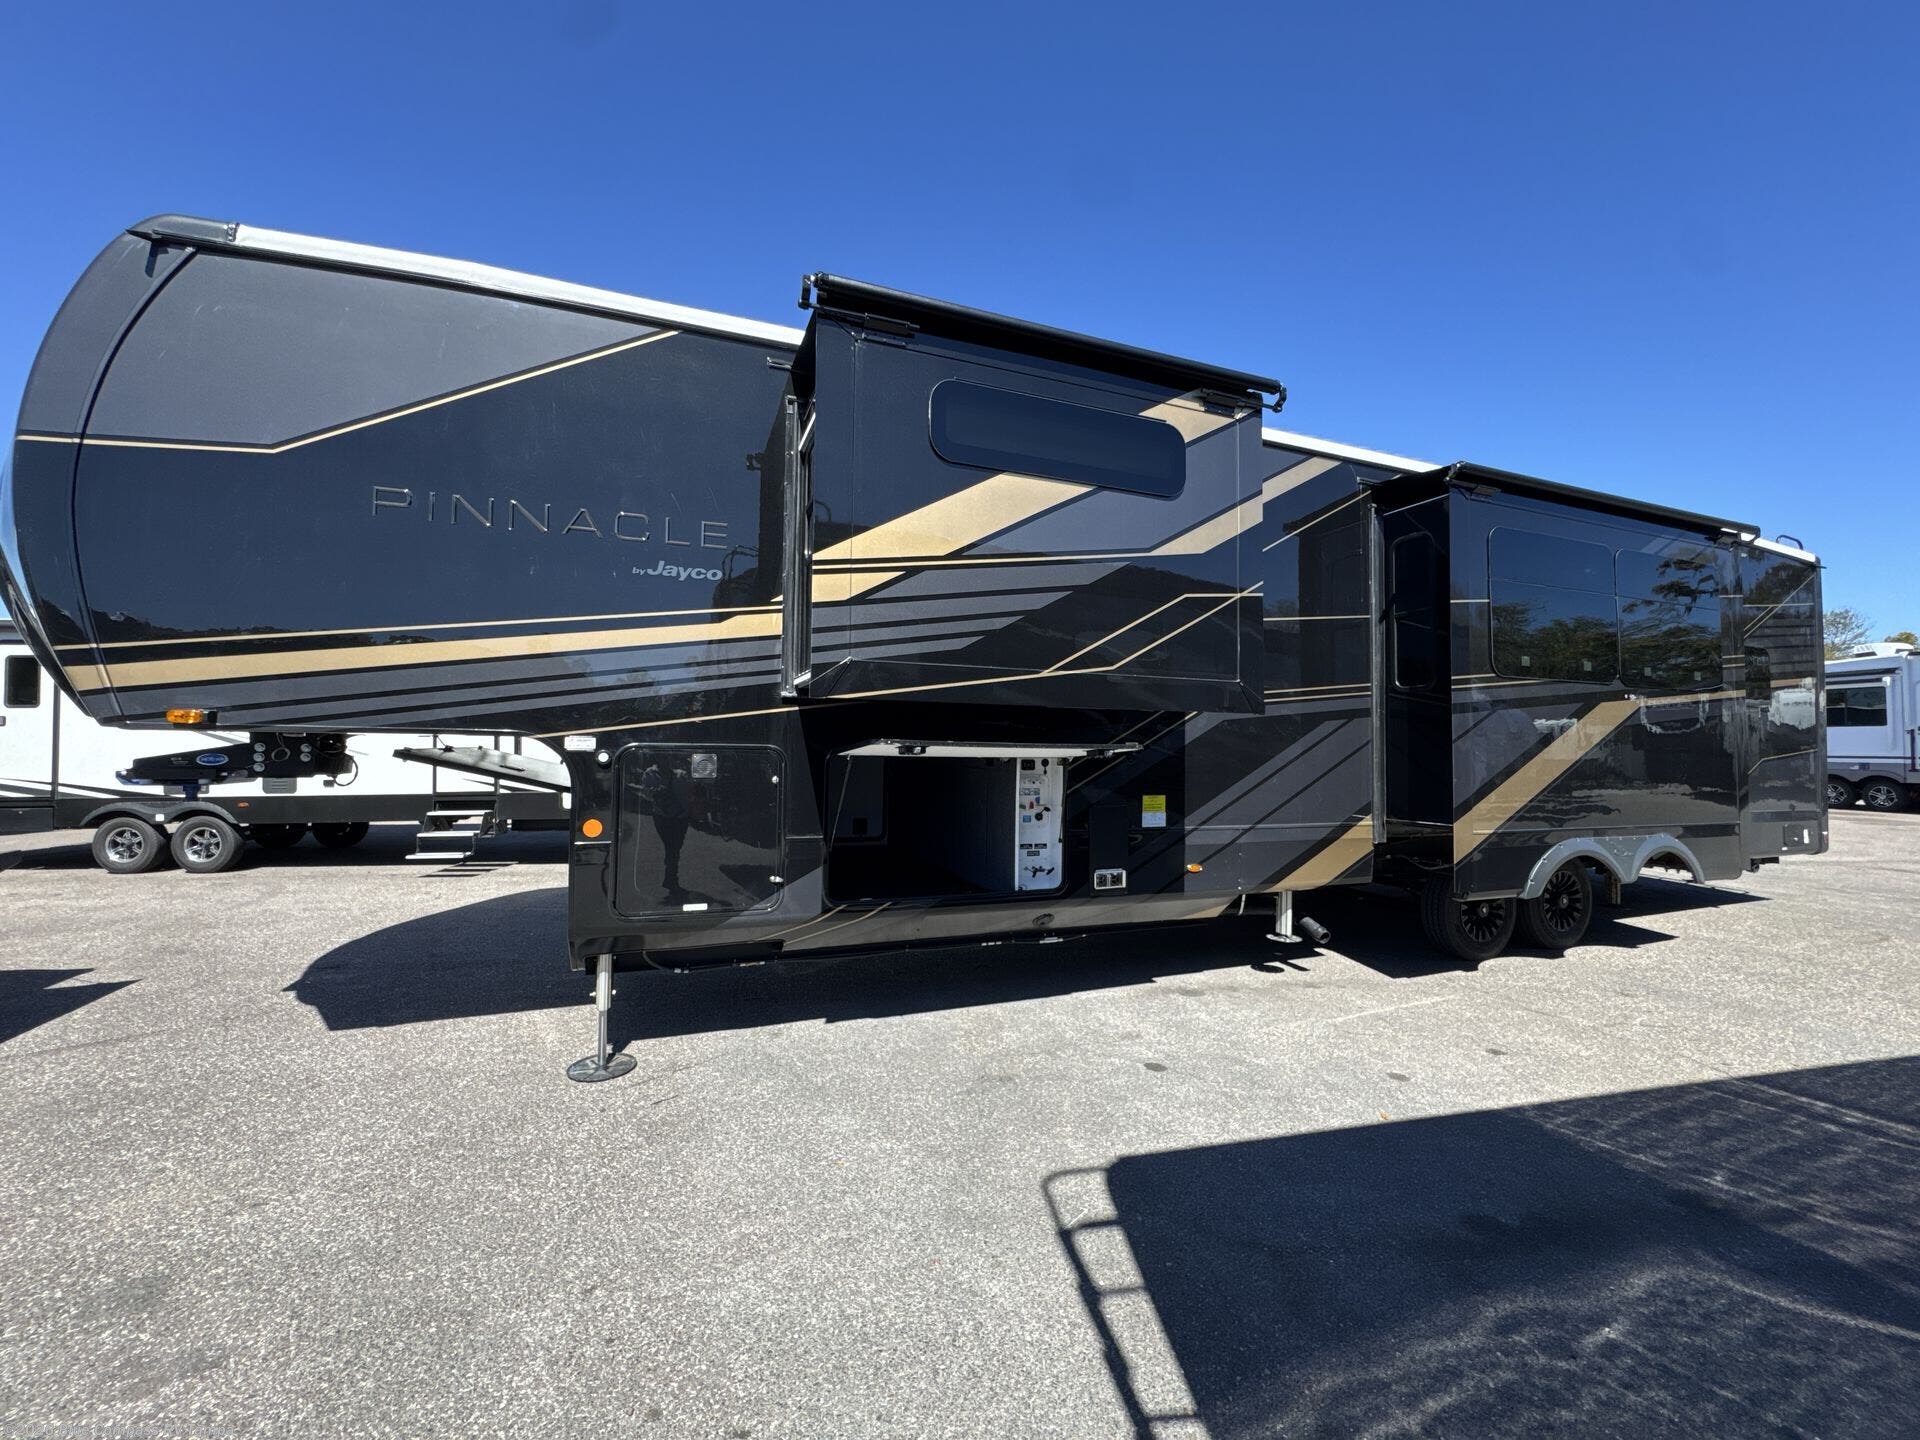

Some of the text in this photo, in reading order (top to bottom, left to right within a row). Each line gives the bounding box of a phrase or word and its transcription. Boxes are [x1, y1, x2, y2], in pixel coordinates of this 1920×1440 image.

[372, 485, 728, 549] PINNACLE
[632, 560, 723, 581] by Jayco
